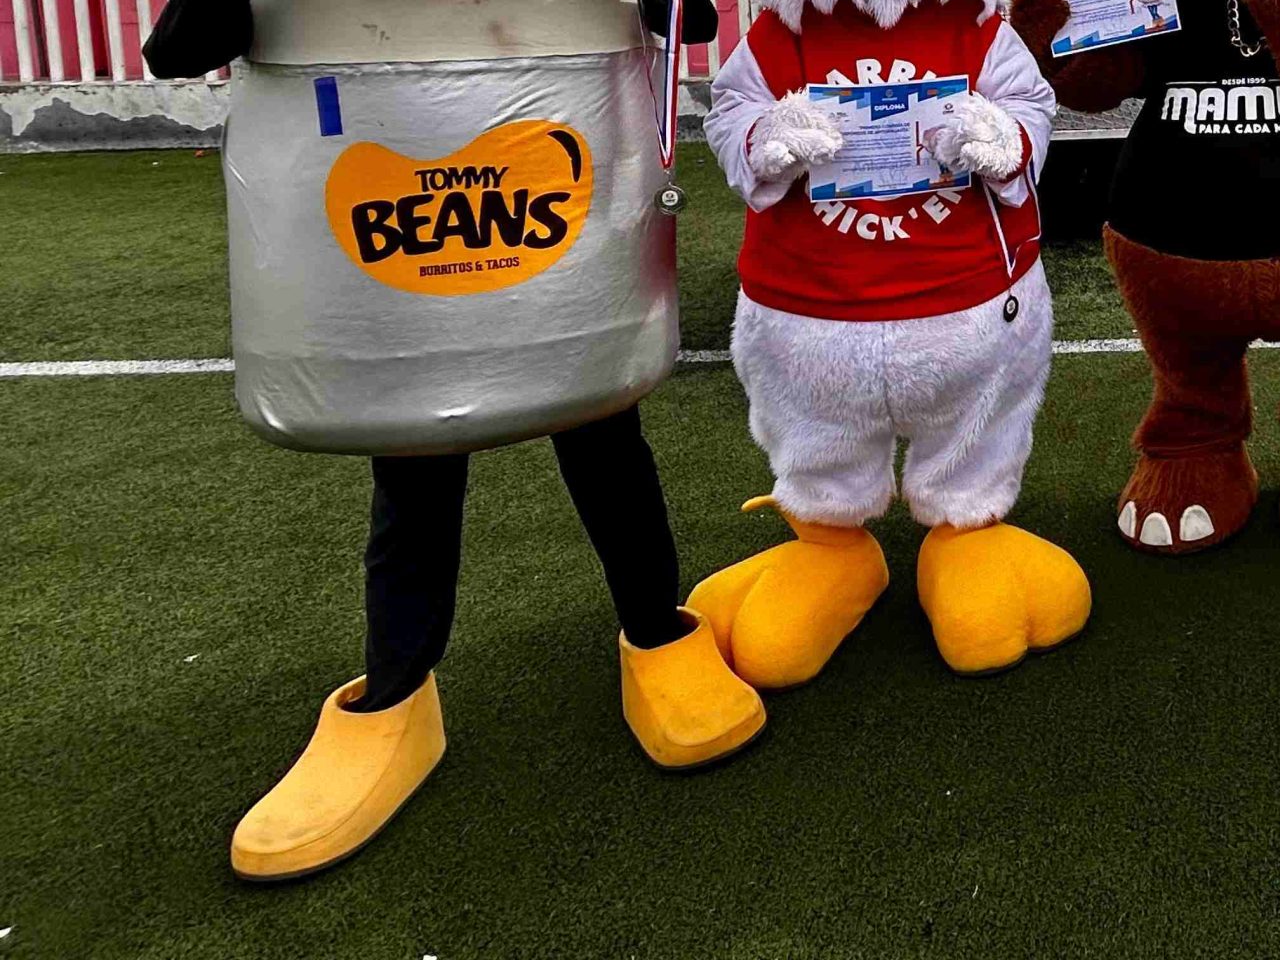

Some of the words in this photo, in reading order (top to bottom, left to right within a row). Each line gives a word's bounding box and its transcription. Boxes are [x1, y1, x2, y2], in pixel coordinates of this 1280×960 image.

[1221, 77, 1246, 85] DESDE
[874, 103, 906, 111] DIPLOMA
[1198, 122, 1230, 134] PARA
[1235, 122, 1271, 134] CADA
[415, 166, 509, 192] TOMMY
[813, 191, 962, 240] HICK'E
[351, 189, 572, 264] BEANS
[419, 261, 473, 277] BURRITOS
[475, 261, 483, 271] &
[487, 257, 520, 270] TACOS
